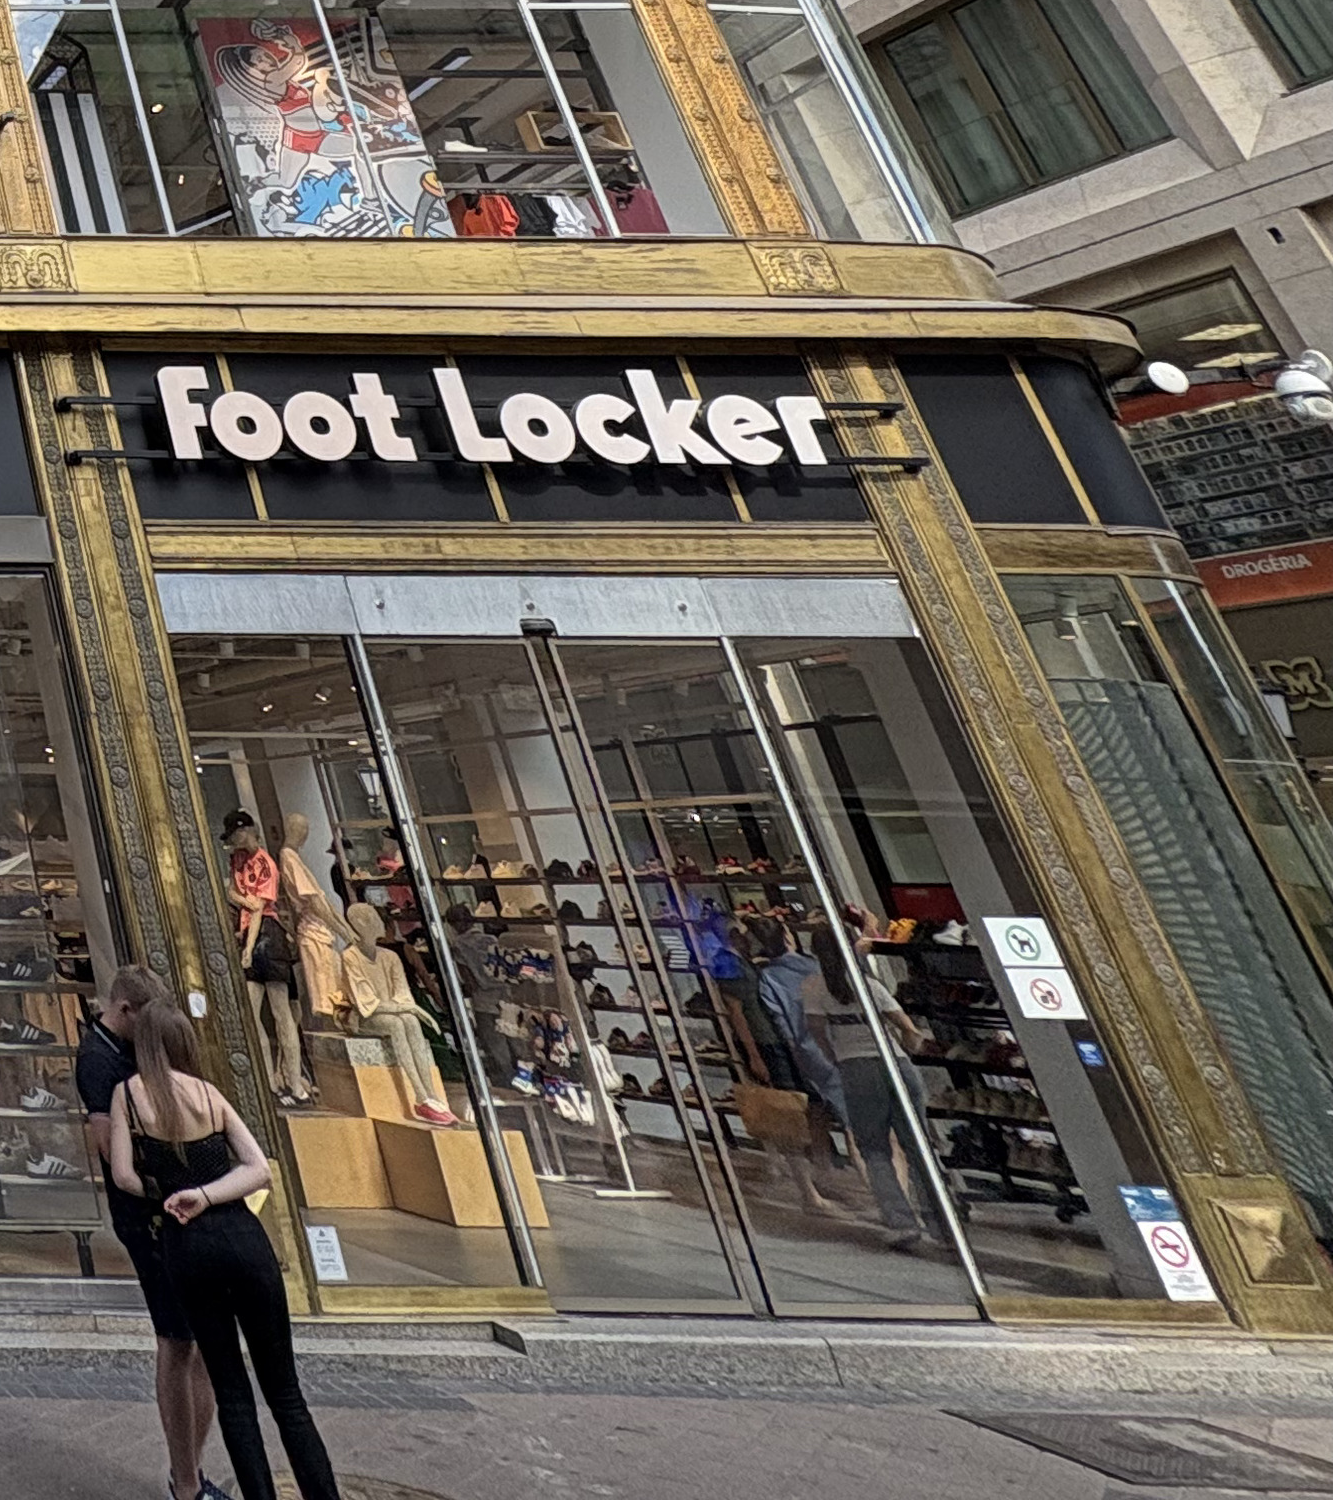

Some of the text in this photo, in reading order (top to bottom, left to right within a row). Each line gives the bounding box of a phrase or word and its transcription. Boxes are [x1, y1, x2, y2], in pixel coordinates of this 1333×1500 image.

[156, 366, 828, 465] Foot Locker
[1221, 553, 1312, 579] DROGÉRIA
